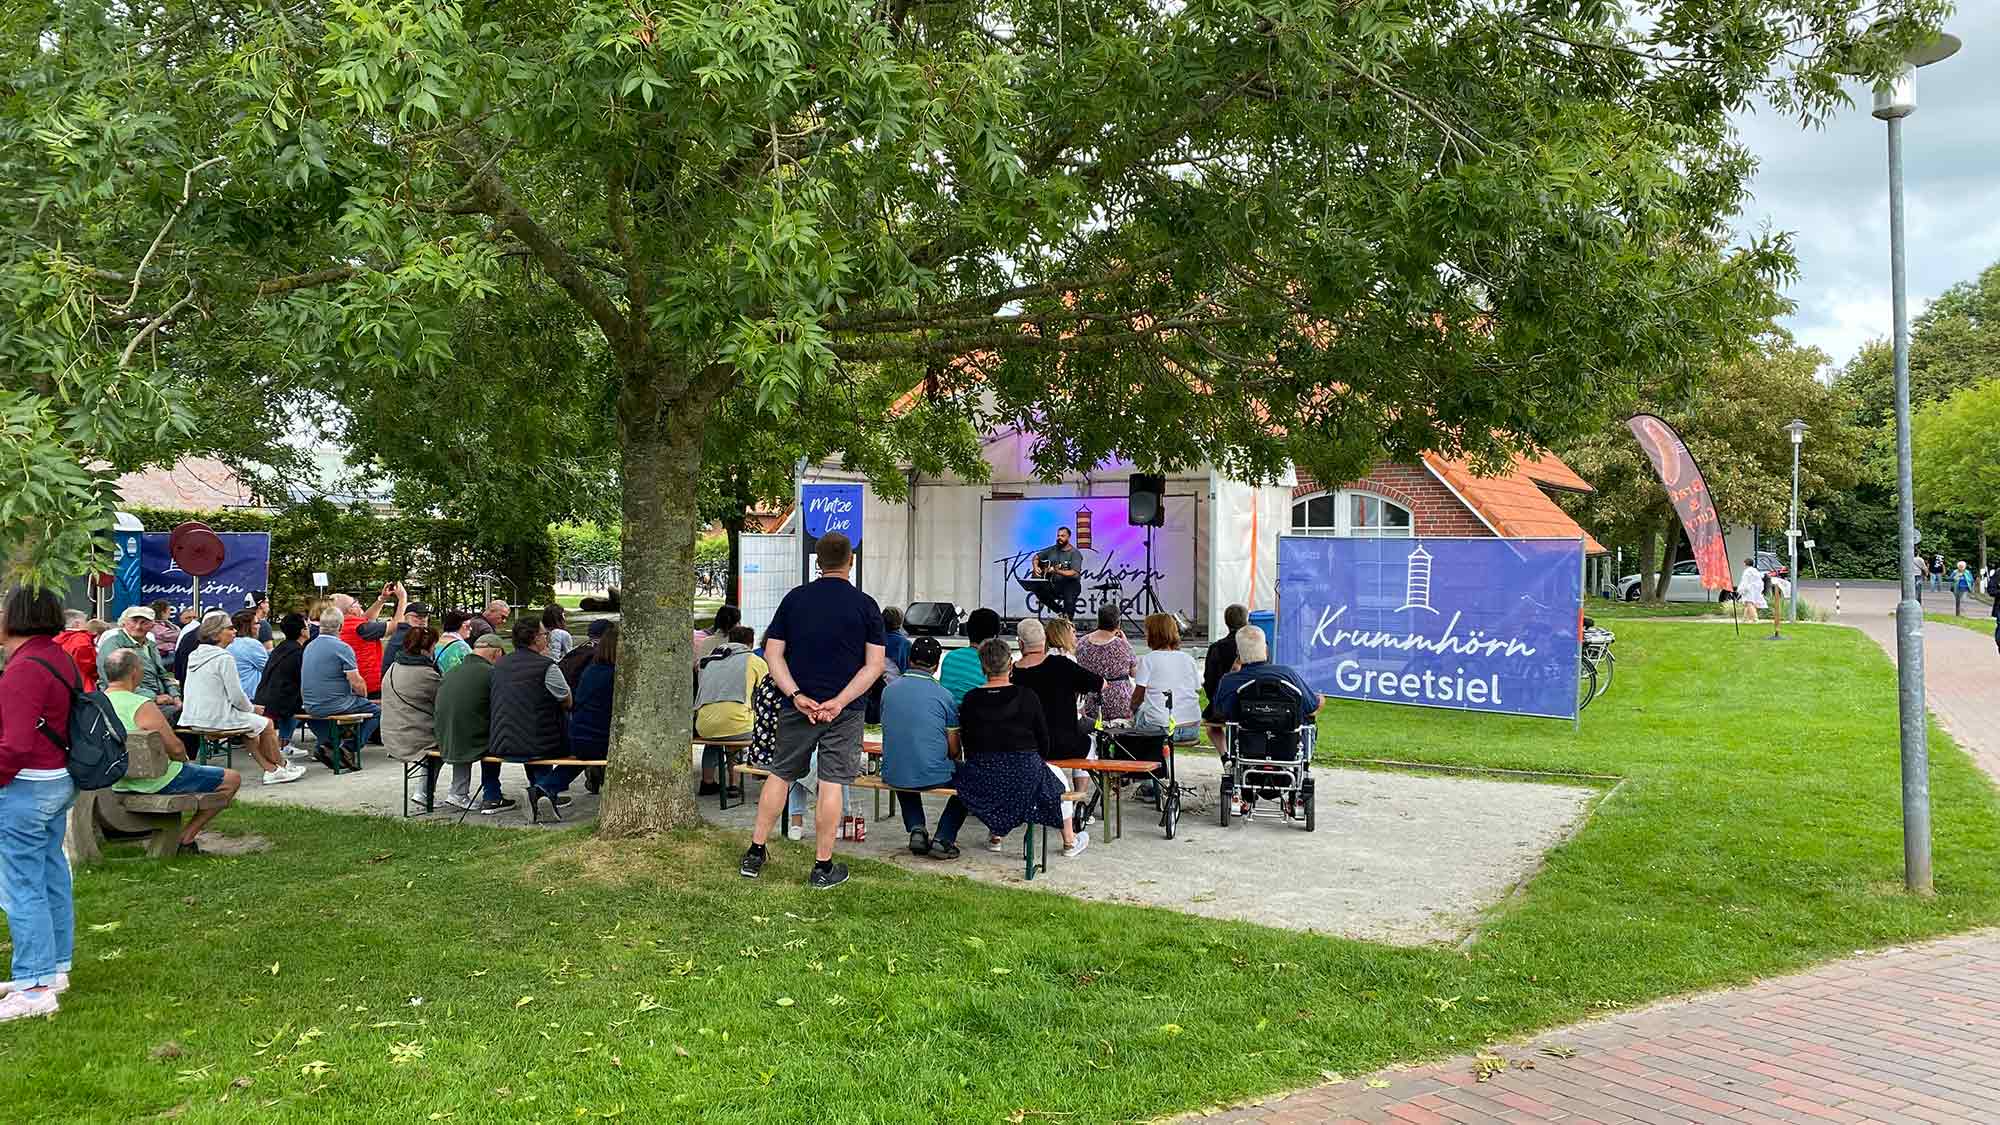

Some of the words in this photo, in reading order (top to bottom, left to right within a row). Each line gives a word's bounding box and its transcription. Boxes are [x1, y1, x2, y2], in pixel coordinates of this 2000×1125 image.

[809, 497, 853, 513] Matze
[825, 513, 851, 532] Live
[1310, 604, 1536, 656] Krummhörn
[1335, 659, 1503, 705] Greetsiel
